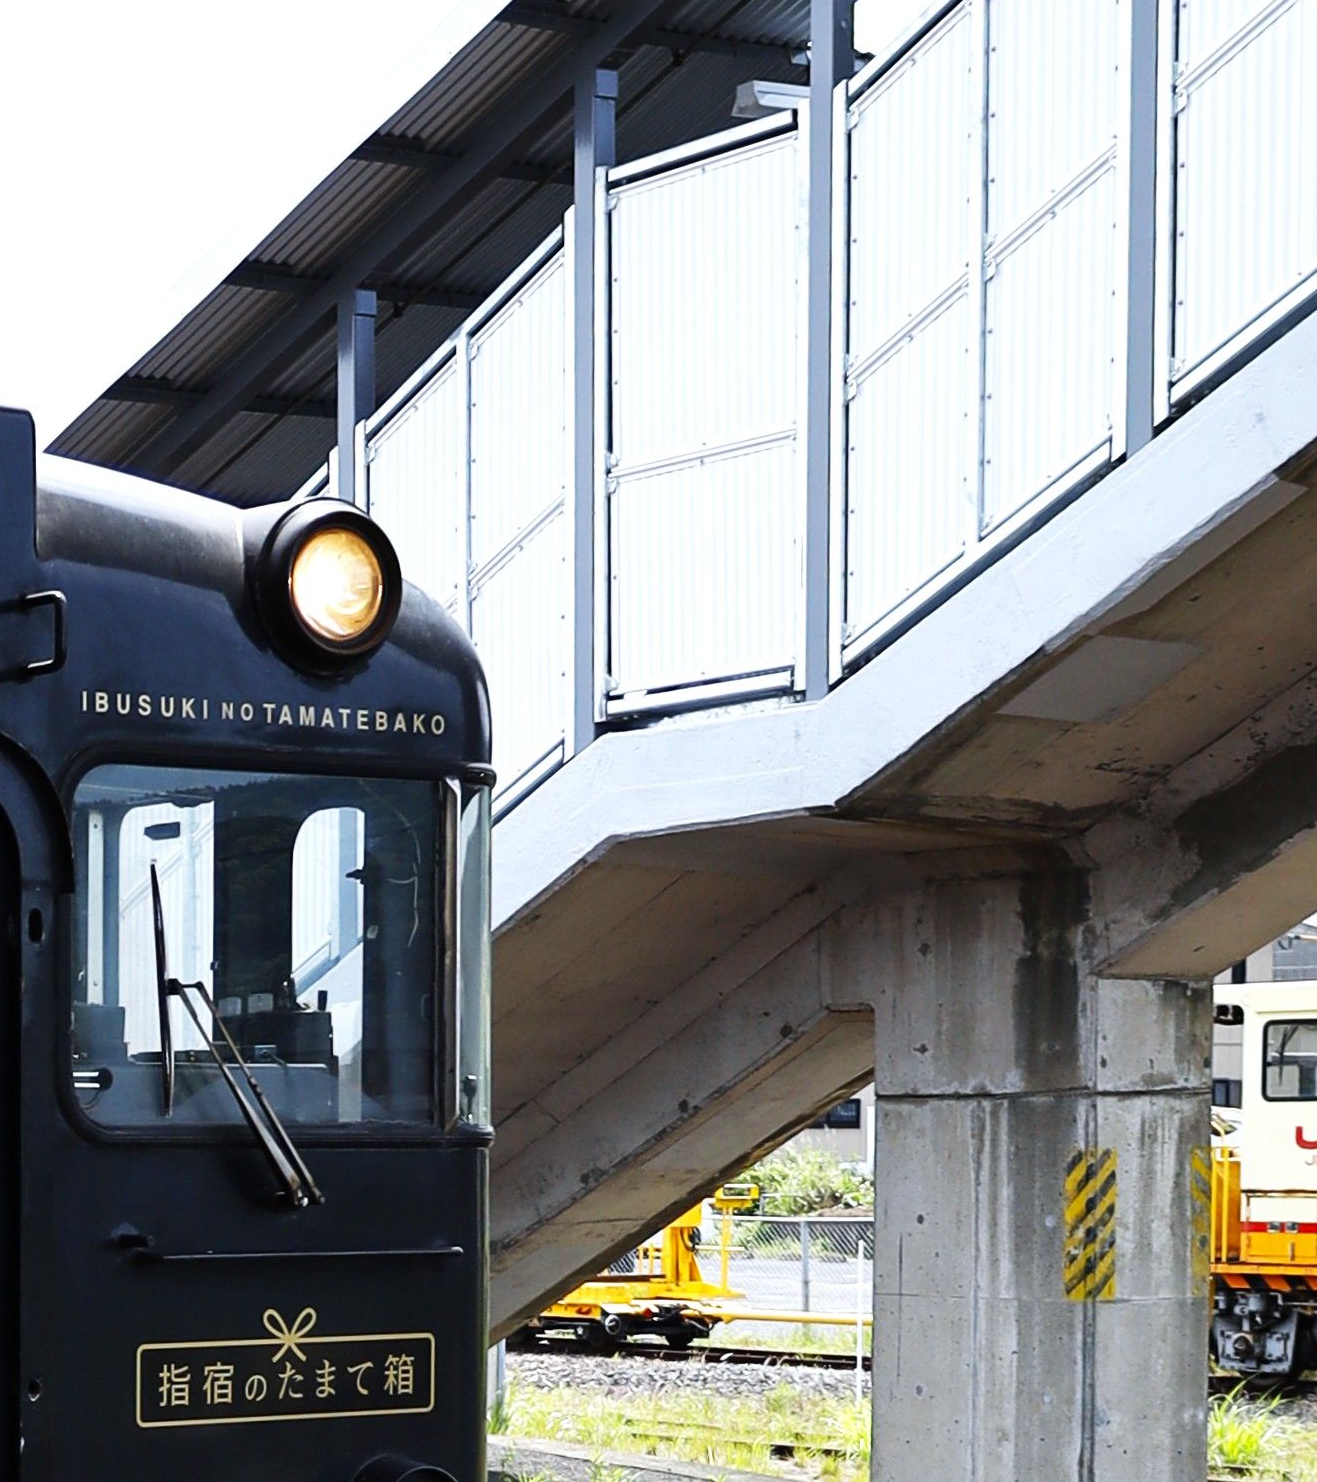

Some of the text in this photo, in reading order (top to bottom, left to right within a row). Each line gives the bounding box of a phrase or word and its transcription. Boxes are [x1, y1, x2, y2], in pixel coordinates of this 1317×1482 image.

[82, 691, 446, 735] IBUSUKI NO TAMATEBAKO
[158, 1353, 415, 1407] 指宿のたまて箱
